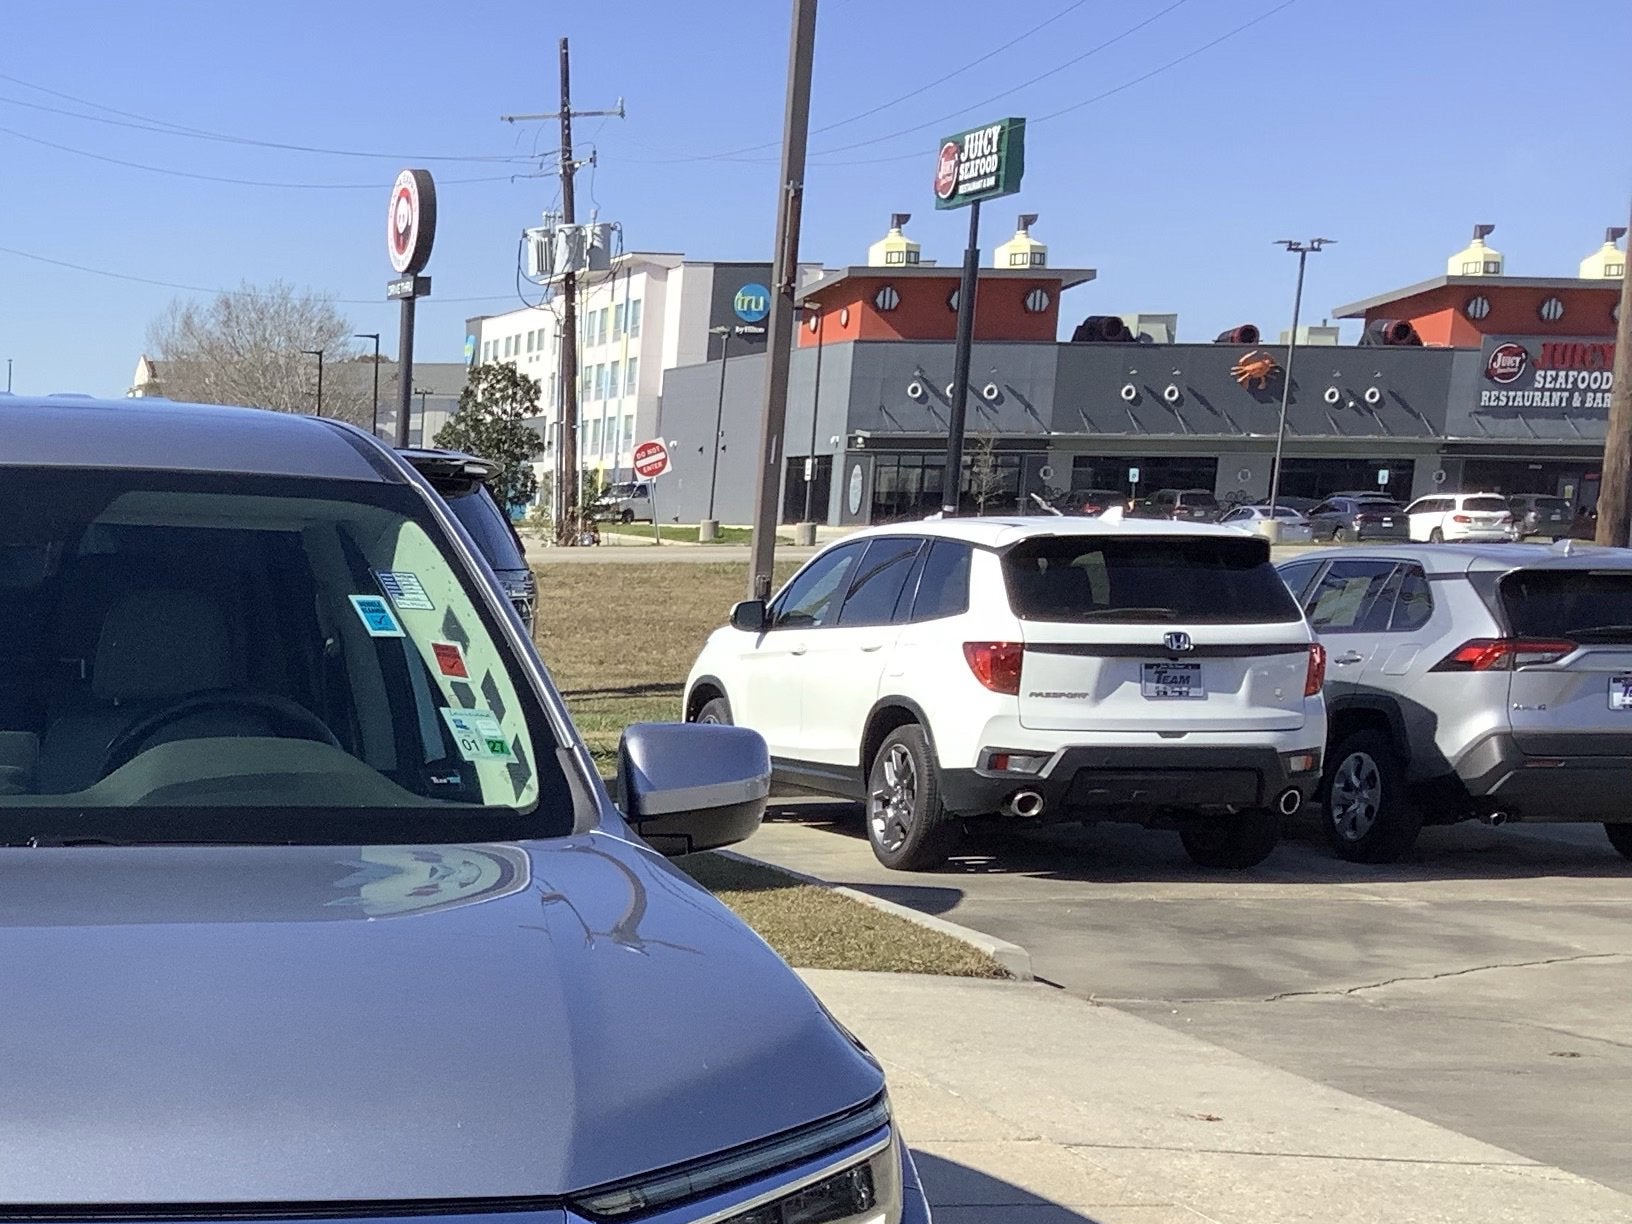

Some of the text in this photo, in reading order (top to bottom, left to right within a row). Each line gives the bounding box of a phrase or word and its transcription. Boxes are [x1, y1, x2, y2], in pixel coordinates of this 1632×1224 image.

[960, 125, 1001, 162] JUICY
[959, 153, 998, 181] SEAFOOD
[737, 291, 765, 312] tru
[1531, 342, 1616, 369] JUICY
[1534, 370, 1613, 389] SEAFOOD
[1480, 391, 1613, 408] RESTAURANT & BAR
[636, 445, 661, 460] DO NOT
[642, 461, 663, 474] ENTER
[1153, 670, 1191, 685] TEAM
[461, 738, 481, 752] 01
[487, 739, 506, 753] 27
